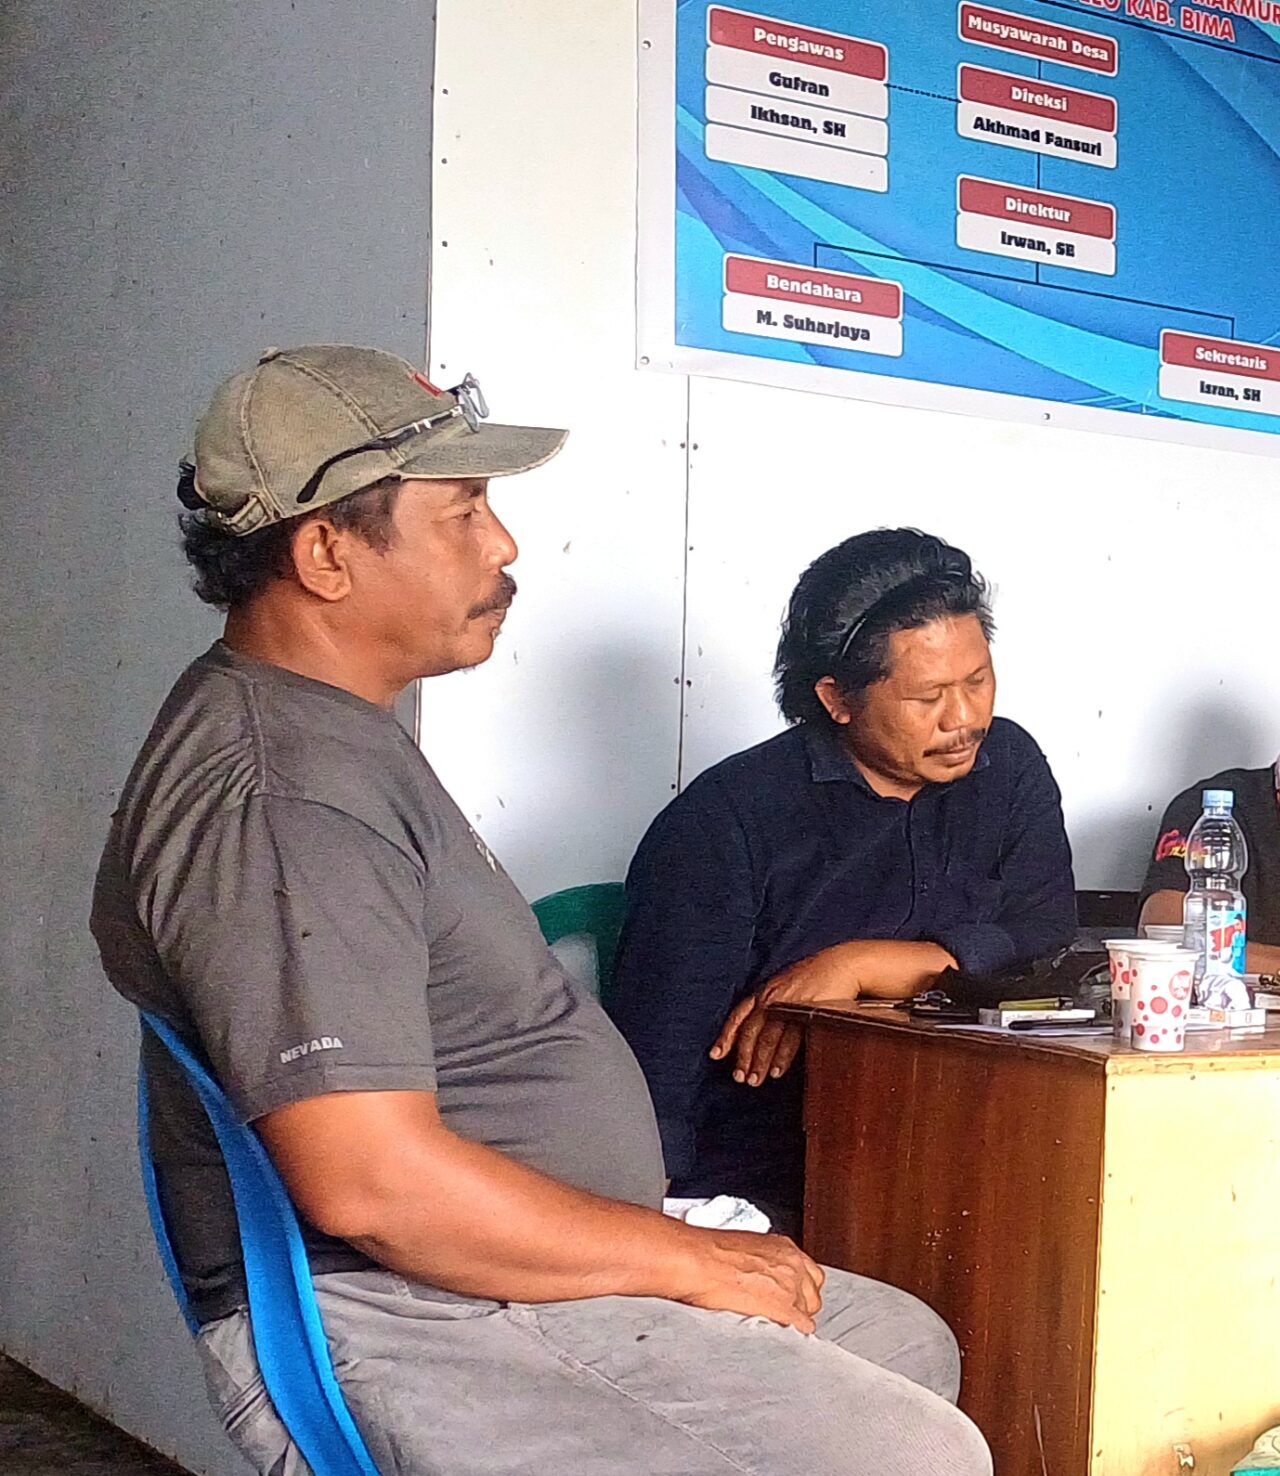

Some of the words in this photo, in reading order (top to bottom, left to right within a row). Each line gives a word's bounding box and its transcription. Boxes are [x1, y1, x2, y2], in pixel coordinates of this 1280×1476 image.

[1126, 0, 1176, 26] KAB.
[1181, 7, 1235, 42] BIMA
[754, 27, 845, 61] Pengawas
[968, 14, 1067, 51] Musyawarah
[1071, 40, 1108, 61] Desa
[769, 72, 829, 97] Gufran
[1011, 86, 1067, 112] Direksi
[751, 105, 817, 134] Ikhsan,
[823, 120, 846, 138] SH
[973, 117, 1040, 143] Akhmad
[1045, 132, 1102, 156] Fansuri
[1005, 197, 1071, 222] Direktur
[1001, 231, 1051, 255] Irwan,
[1056, 242, 1075, 257] SE
[767, 274, 862, 303] Bendahara
[757, 310, 778, 326] M.
[783, 314, 870, 341] Suharjaya
[1196, 348, 1267, 370] Sekretaris
[1200, 380, 1239, 401] Isran,
[1243, 387, 1261, 402] SH
[280, 1037, 343, 1064] NEVADA
